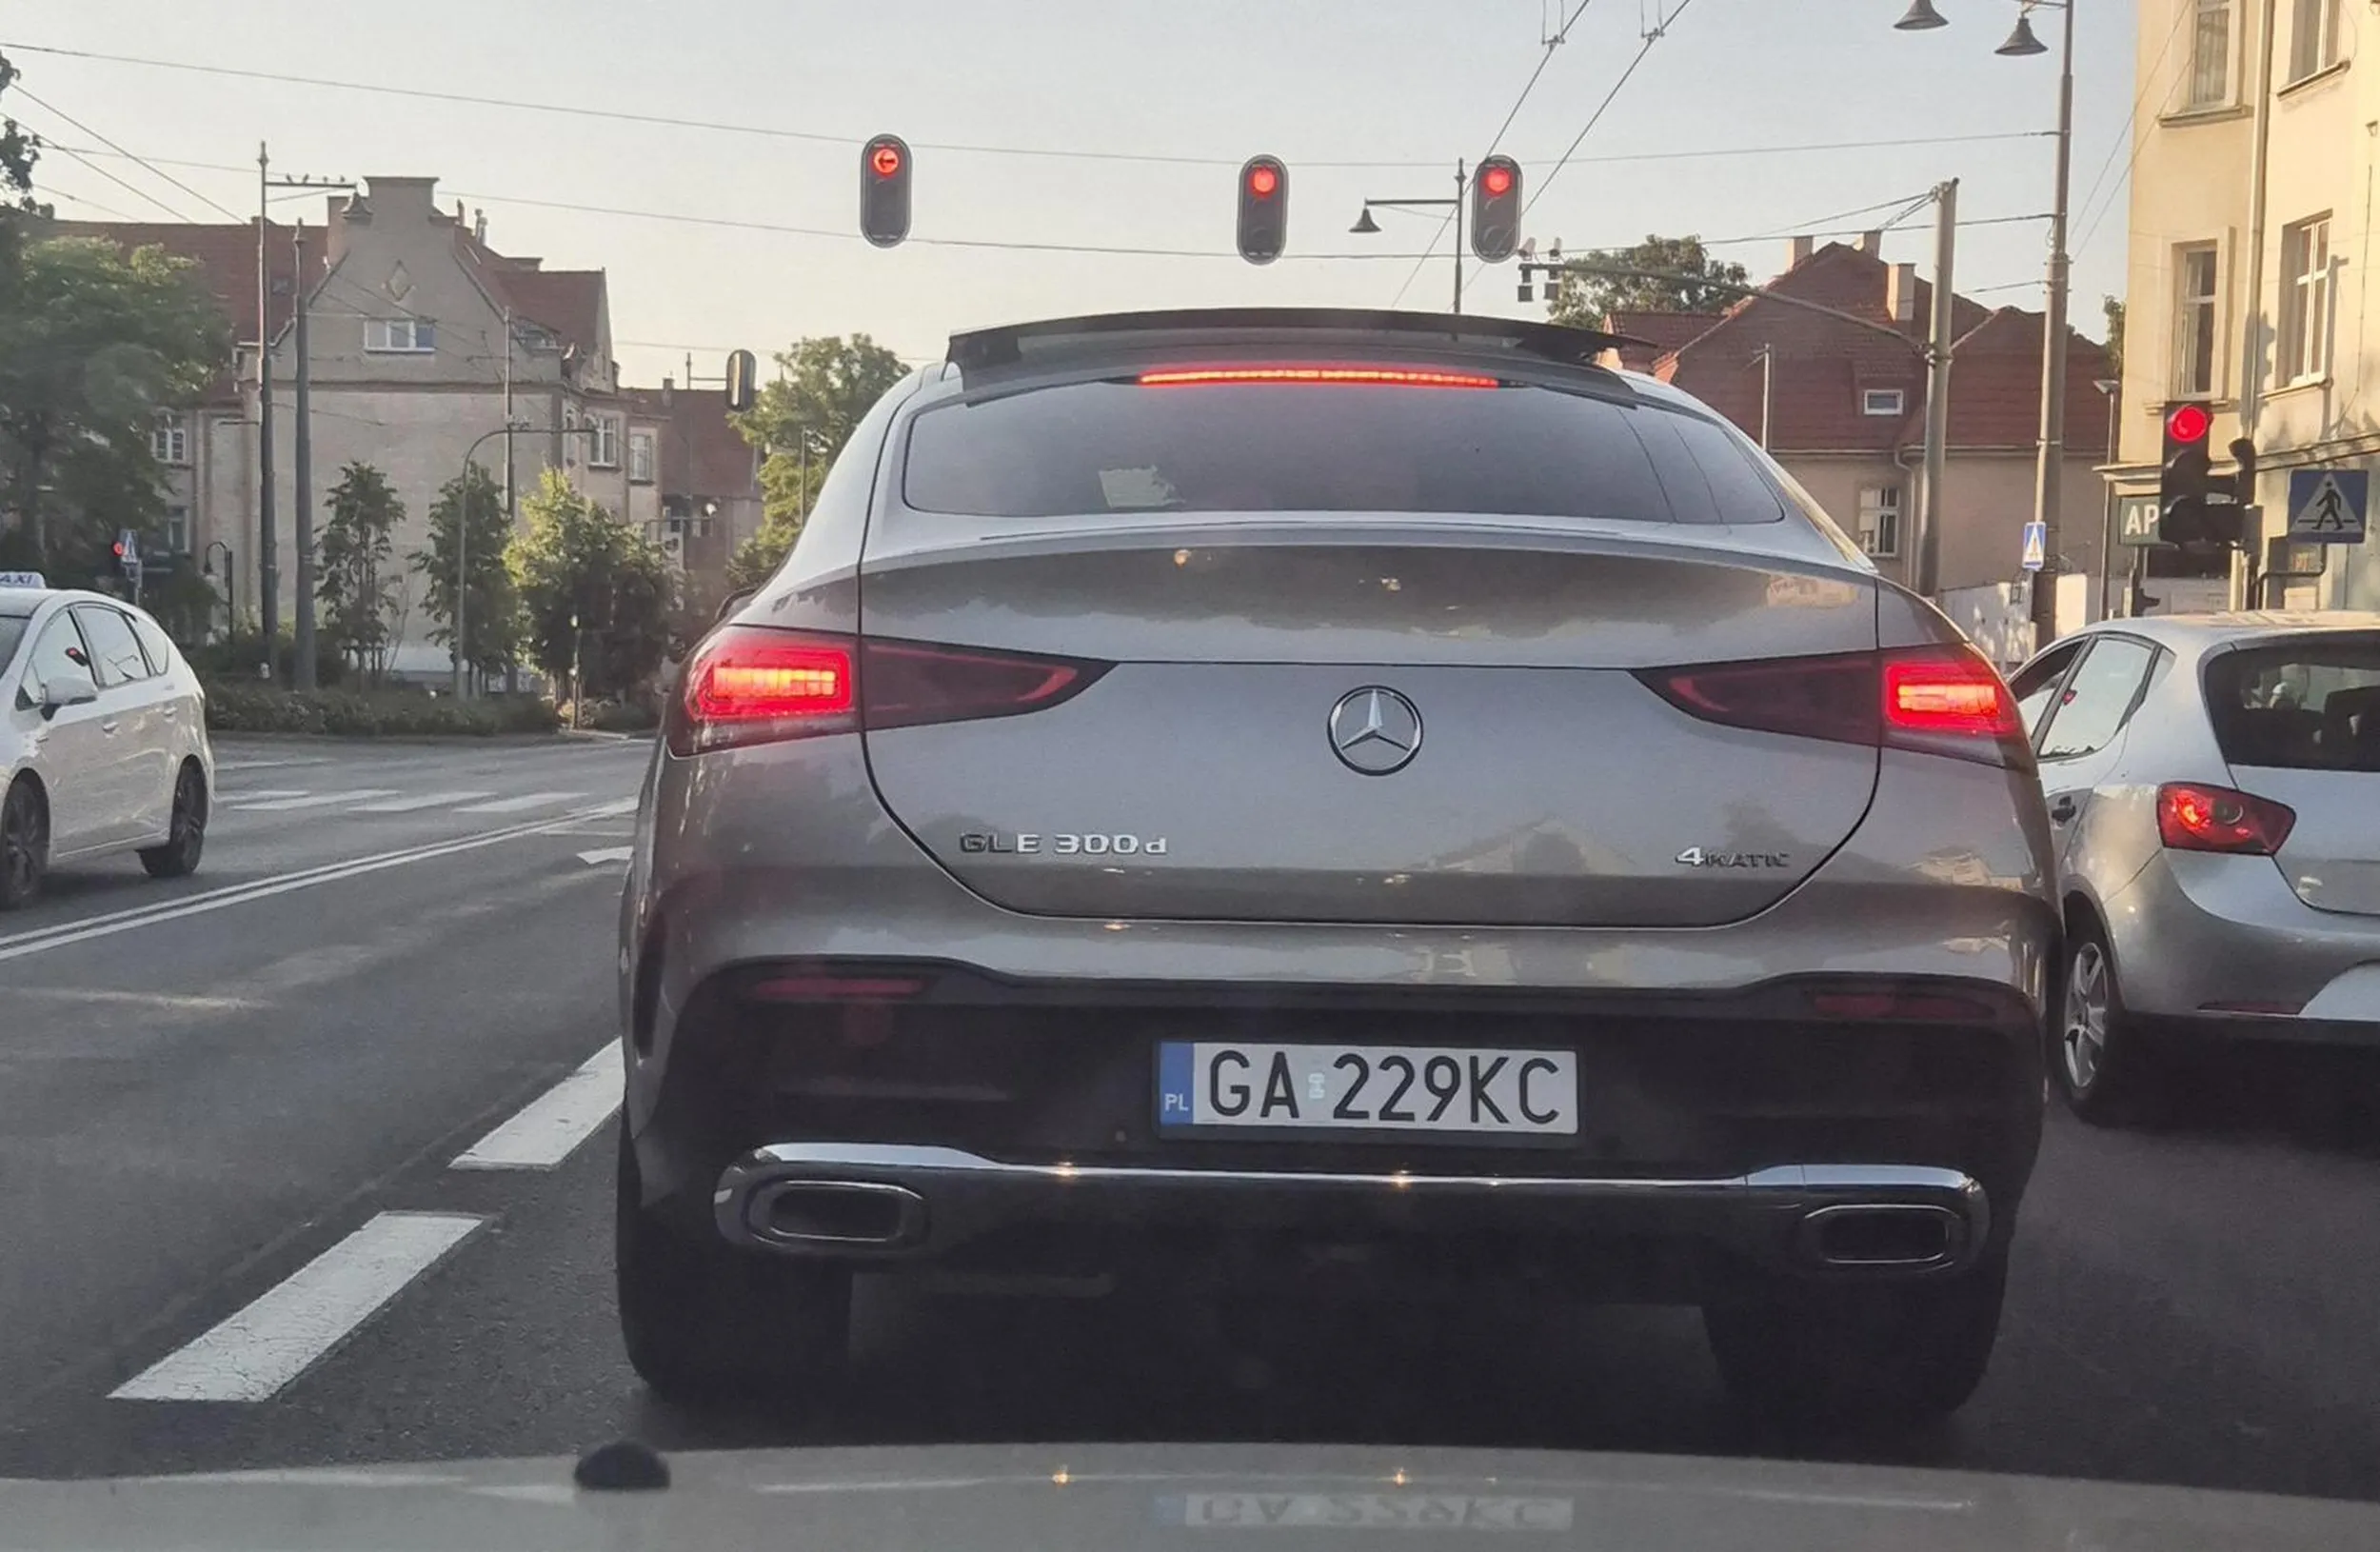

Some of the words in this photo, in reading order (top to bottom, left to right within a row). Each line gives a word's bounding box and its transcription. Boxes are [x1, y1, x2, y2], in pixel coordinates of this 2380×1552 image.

[2125, 505, 2160, 535] AP
[0, 574, 32, 584] AXI
[960, 833, 1042, 854] GLE
[1676, 846, 1791, 868] 4MATIC
[1209, 1049, 1300, 1119] GA
[1333, 1053, 1560, 1124] 229KC
[1164, 1093, 1189, 1111] PL
